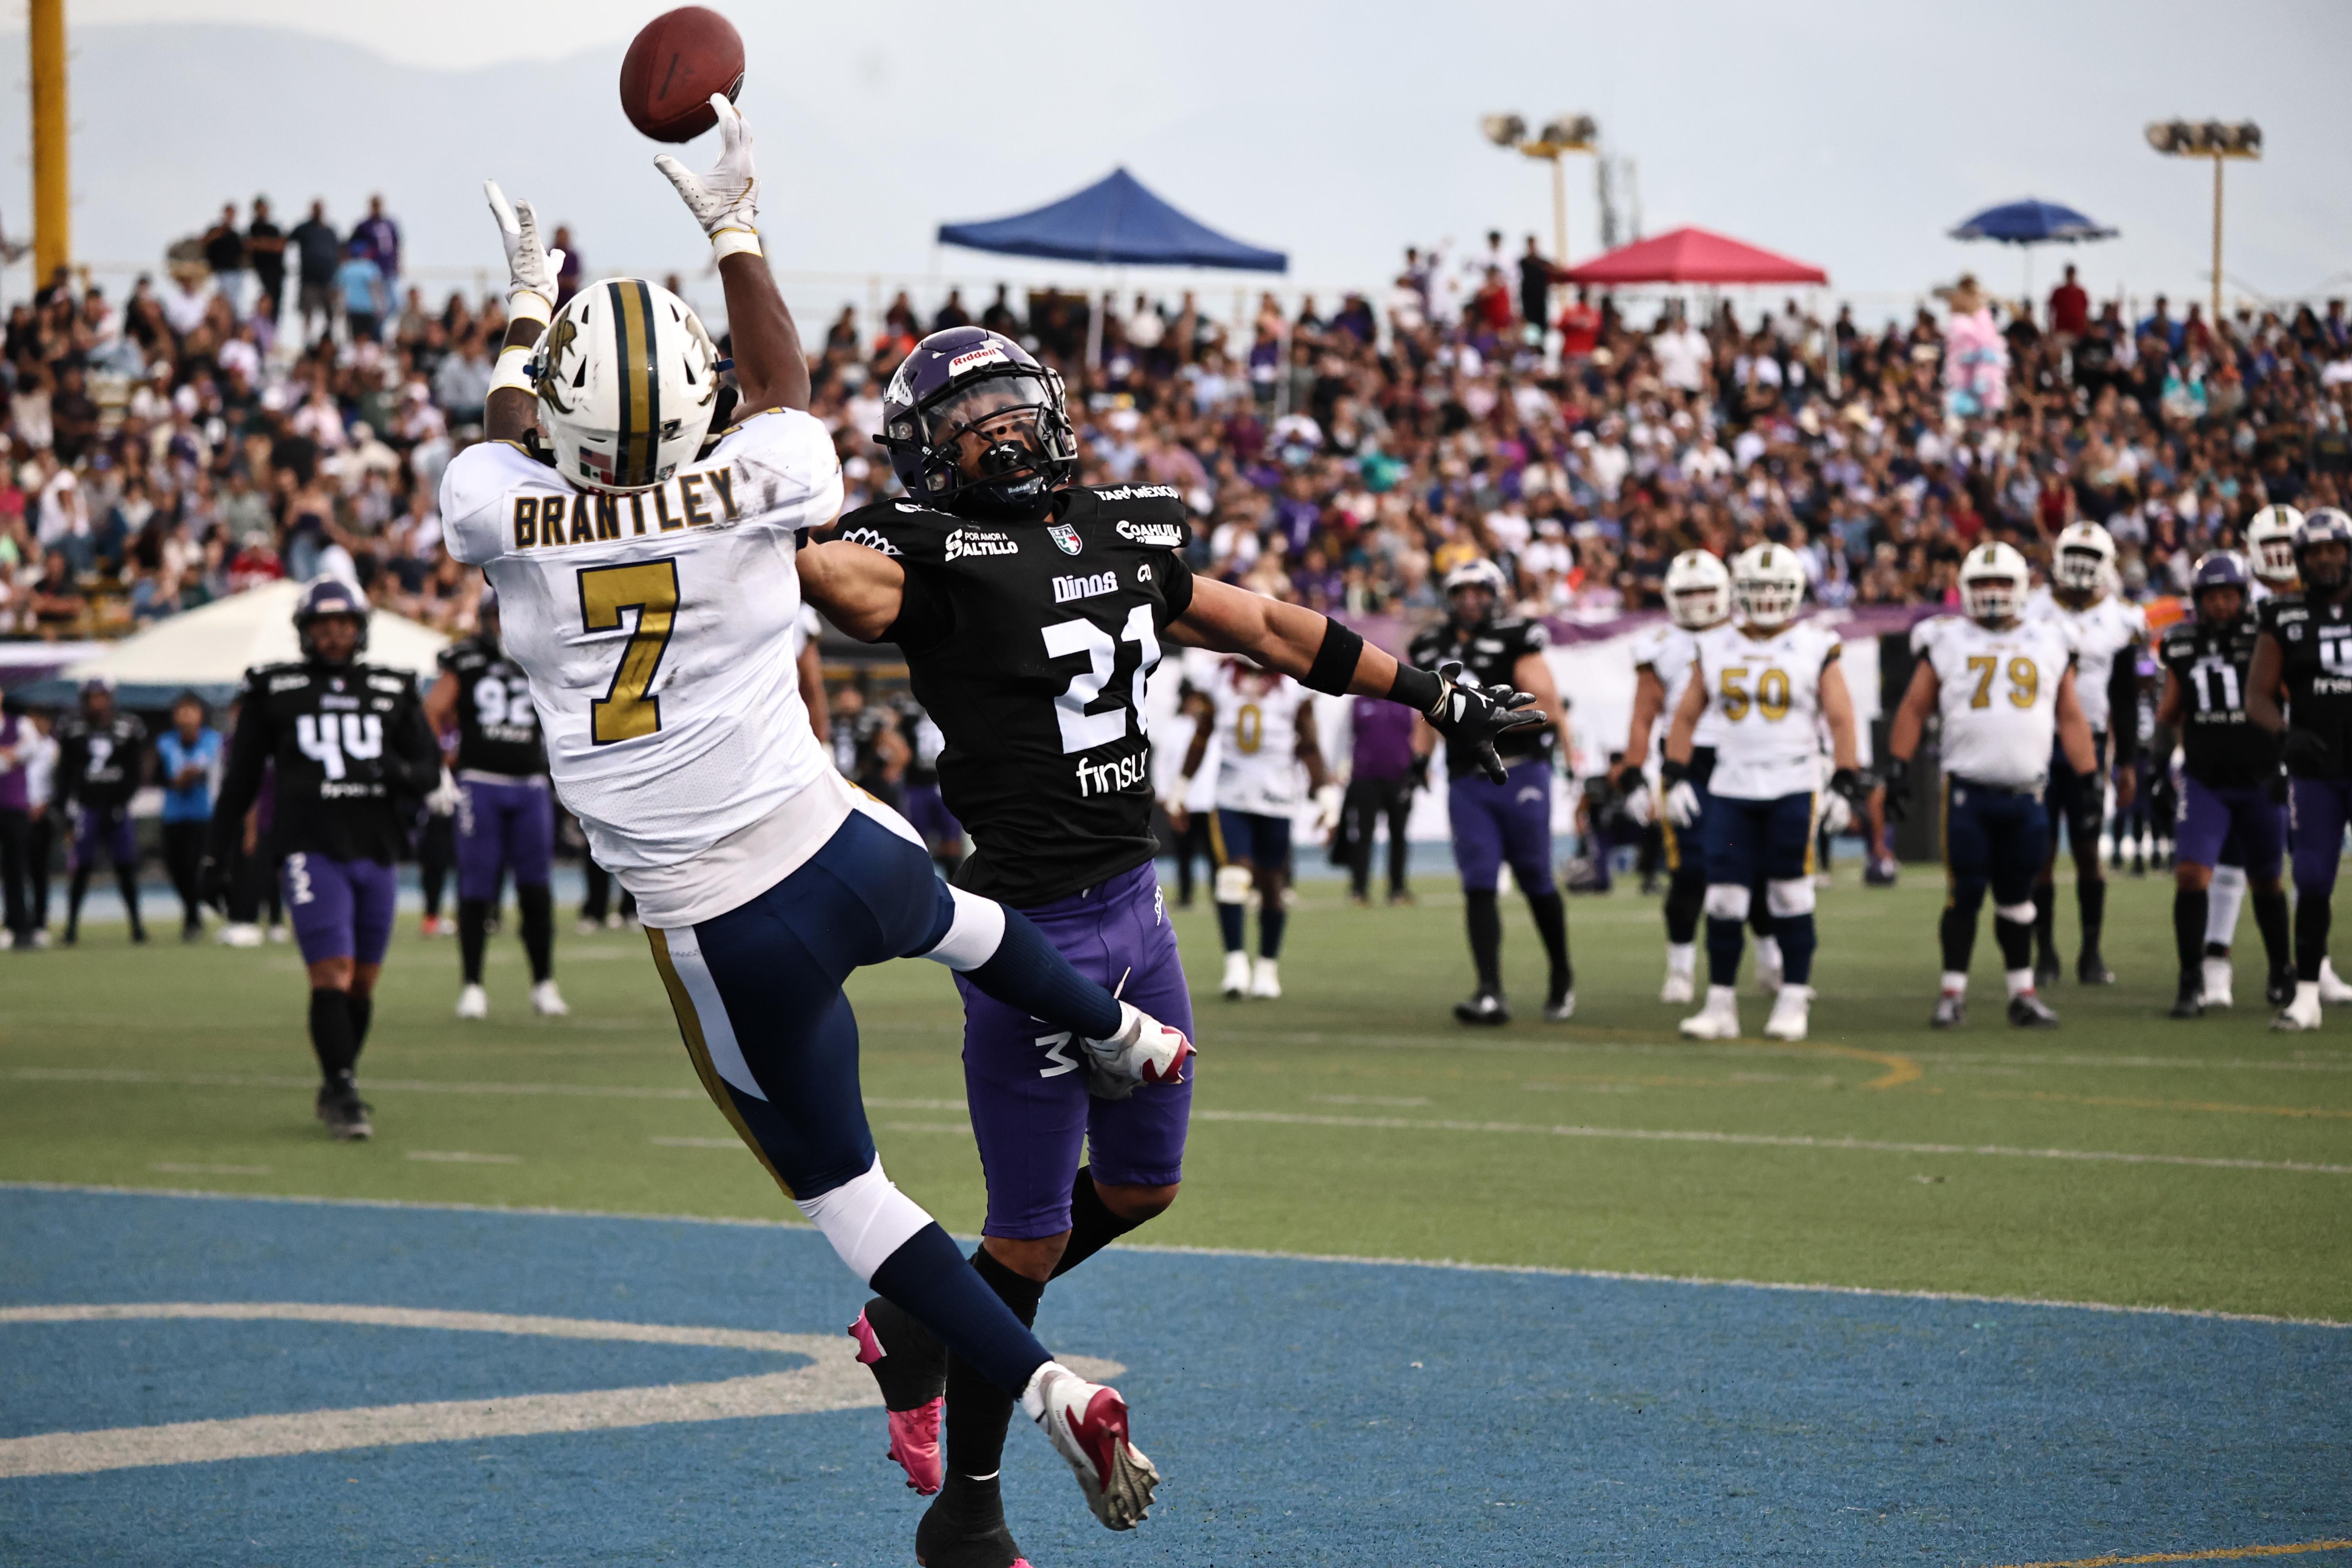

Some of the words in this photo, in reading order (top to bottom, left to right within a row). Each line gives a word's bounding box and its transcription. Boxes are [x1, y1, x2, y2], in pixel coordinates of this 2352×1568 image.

[953, 349, 996, 366] Riddell
[659, 418, 681, 443] 7
[514, 466, 739, 548] BRANTLEY
[1008, 484, 1031, 494] Riddell
[964, 532, 980, 541] POR
[981, 532, 1002, 541] AMOR
[1052, 571, 1118, 603] Dinos
[577, 557, 680, 746] 7
[473, 677, 536, 725] 92
[1041, 603, 1161, 754] 21
[1721, 668, 1790, 722] 50
[1967, 657, 2038, 709] 79
[2189, 665, 2240, 712] 11
[1238, 704, 1261, 754] 0
